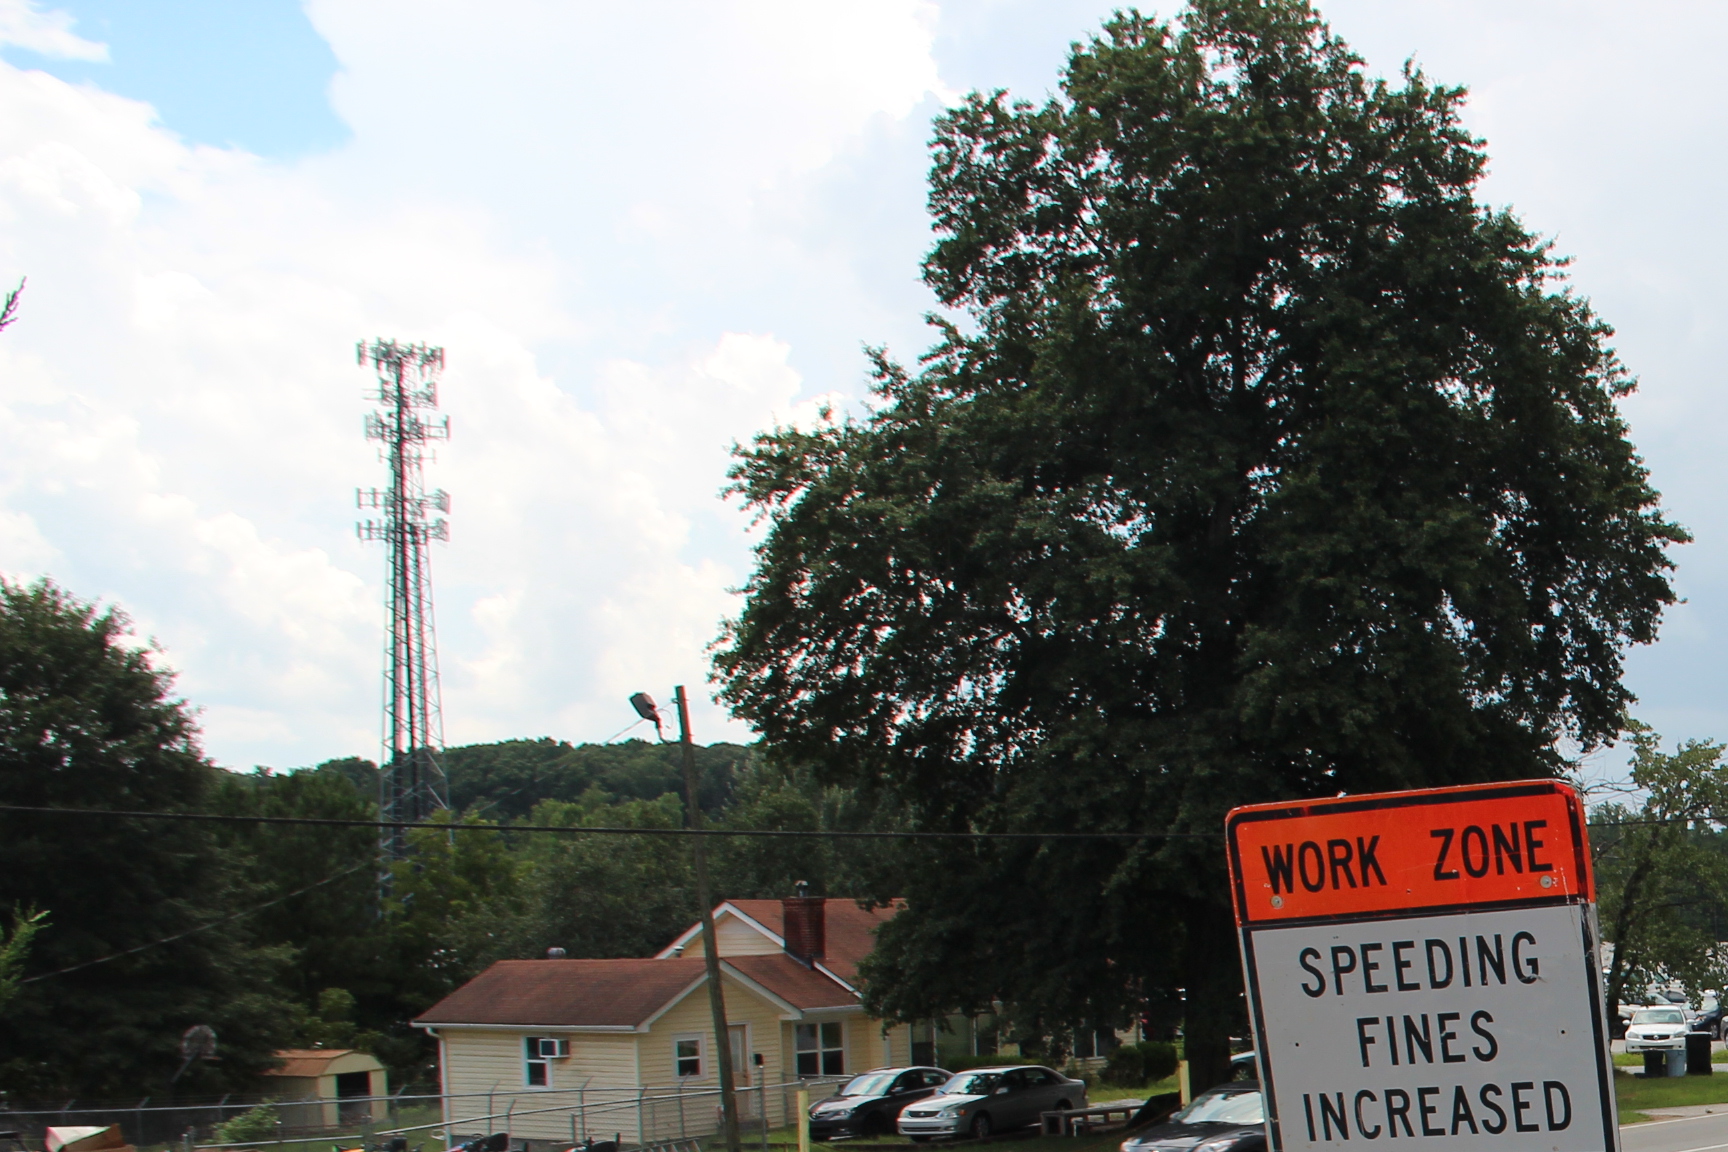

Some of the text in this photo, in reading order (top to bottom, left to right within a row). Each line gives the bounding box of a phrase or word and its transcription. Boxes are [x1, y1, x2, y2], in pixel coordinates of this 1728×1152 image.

[1261, 820, 1554, 895] WORK ZONE
[1300, 931, 1541, 998] SPEEDING
[1356, 1010, 1499, 1067] FINES
[1302, 1080, 1572, 1142] INCREASED
